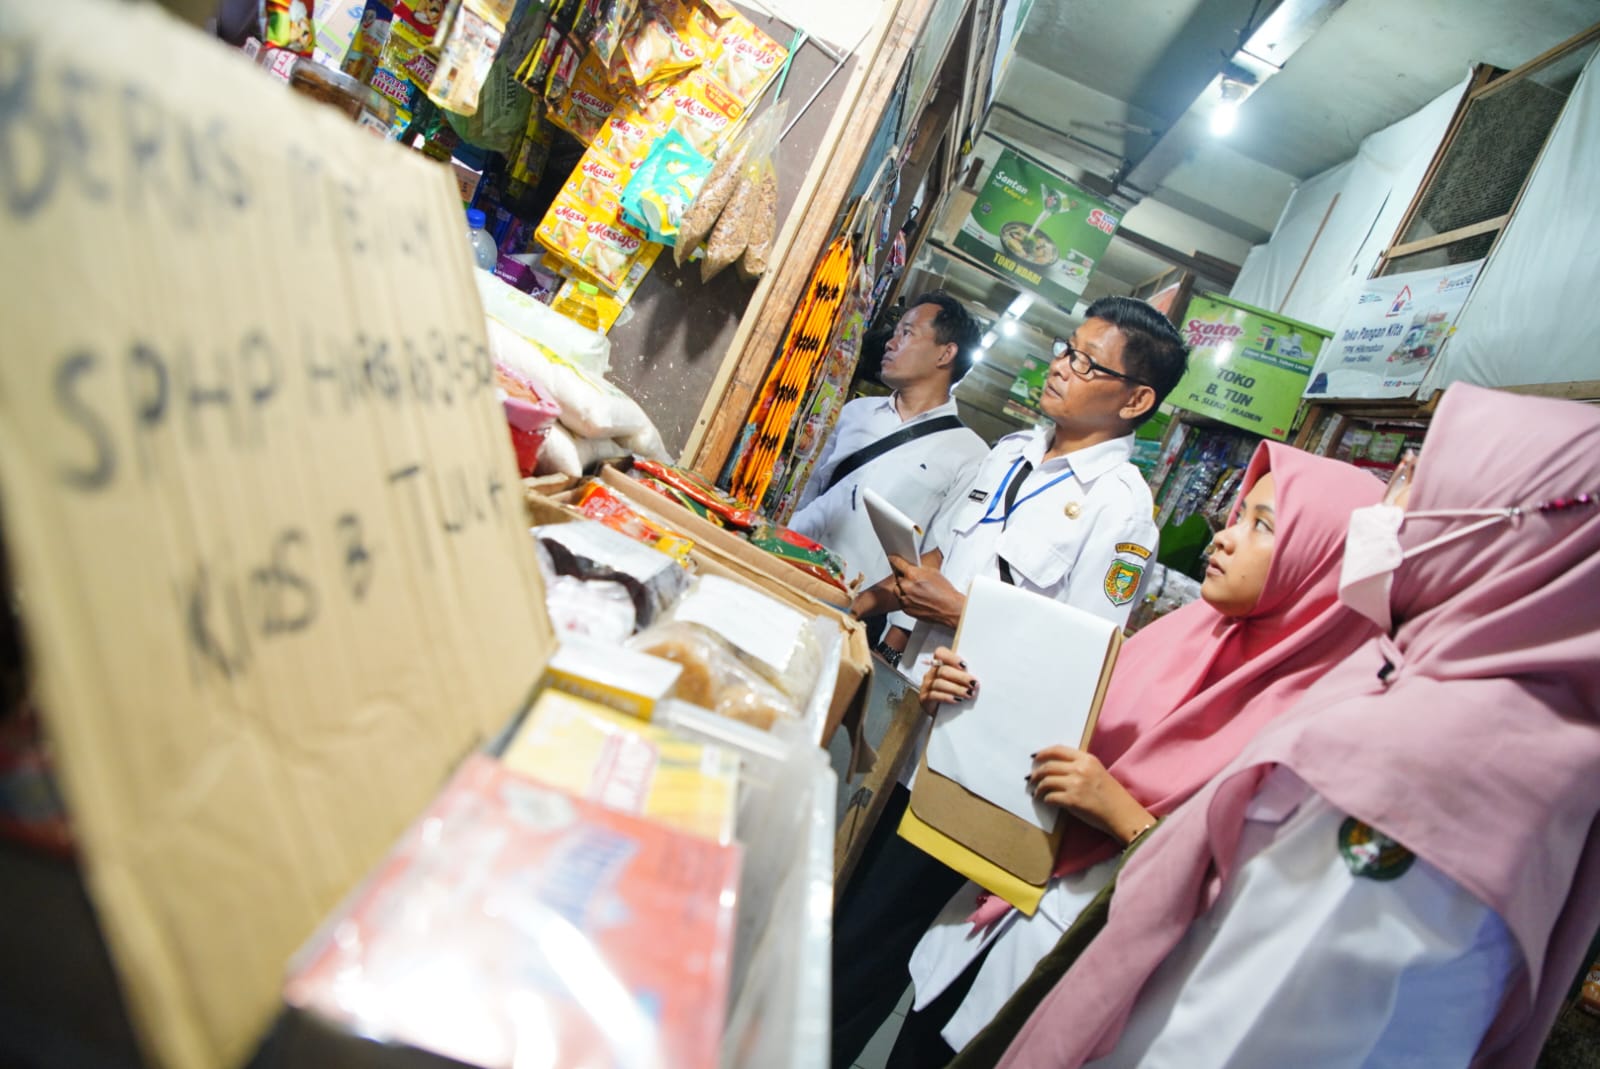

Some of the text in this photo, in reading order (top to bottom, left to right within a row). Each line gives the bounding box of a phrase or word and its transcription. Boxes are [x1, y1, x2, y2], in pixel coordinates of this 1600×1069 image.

[571, 90, 615, 113] Masako
[995, 170, 1029, 195] Santan
[587, 222, 639, 250] Masako
[993, 252, 1016, 273] TOKO
[1358, 325, 1386, 341] Pangan
[1386, 322, 1404, 336] Kita
[1217, 368, 1255, 389] TOKO
[1205, 383, 1254, 407] B. TUN
